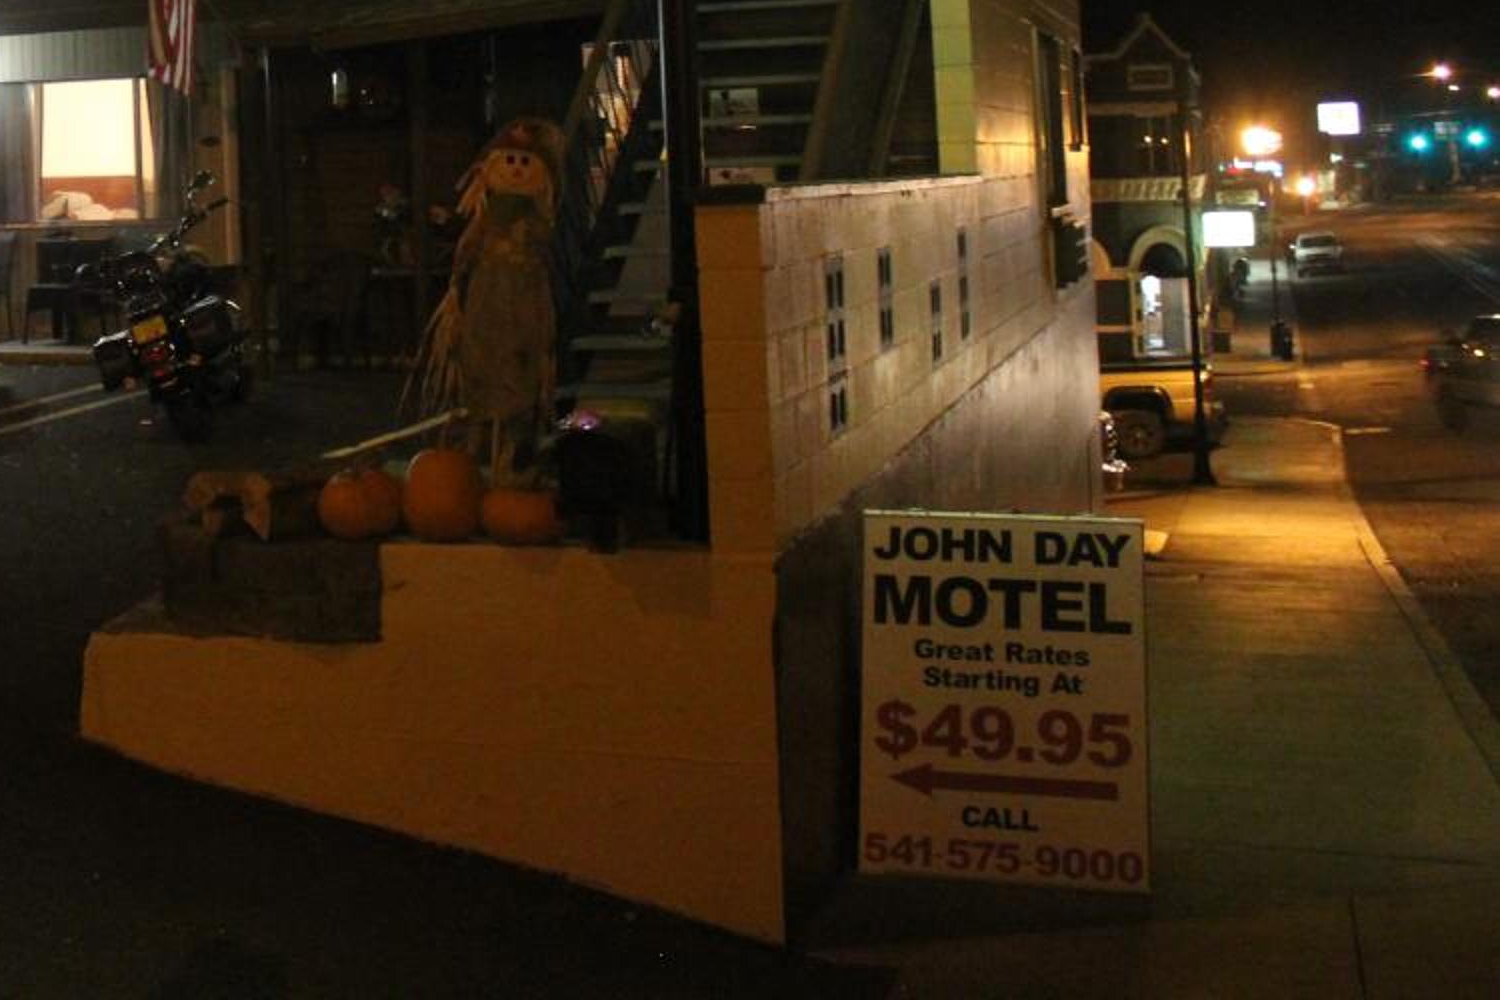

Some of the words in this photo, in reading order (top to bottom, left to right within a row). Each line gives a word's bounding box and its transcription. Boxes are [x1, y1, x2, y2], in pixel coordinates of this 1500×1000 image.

[873, 526, 1014, 564] JOHN
[1034, 530, 1132, 568] DAY
[873, 575, 1133, 635] MOTEL
[914, 638, 995, 662] Great
[1005, 642, 1090, 666] Rates
[923, 666, 1040, 697] Starting
[1052, 673, 1084, 695] At
[873, 700, 1133, 768] $49.95
[961, 805, 1039, 832] CALL
